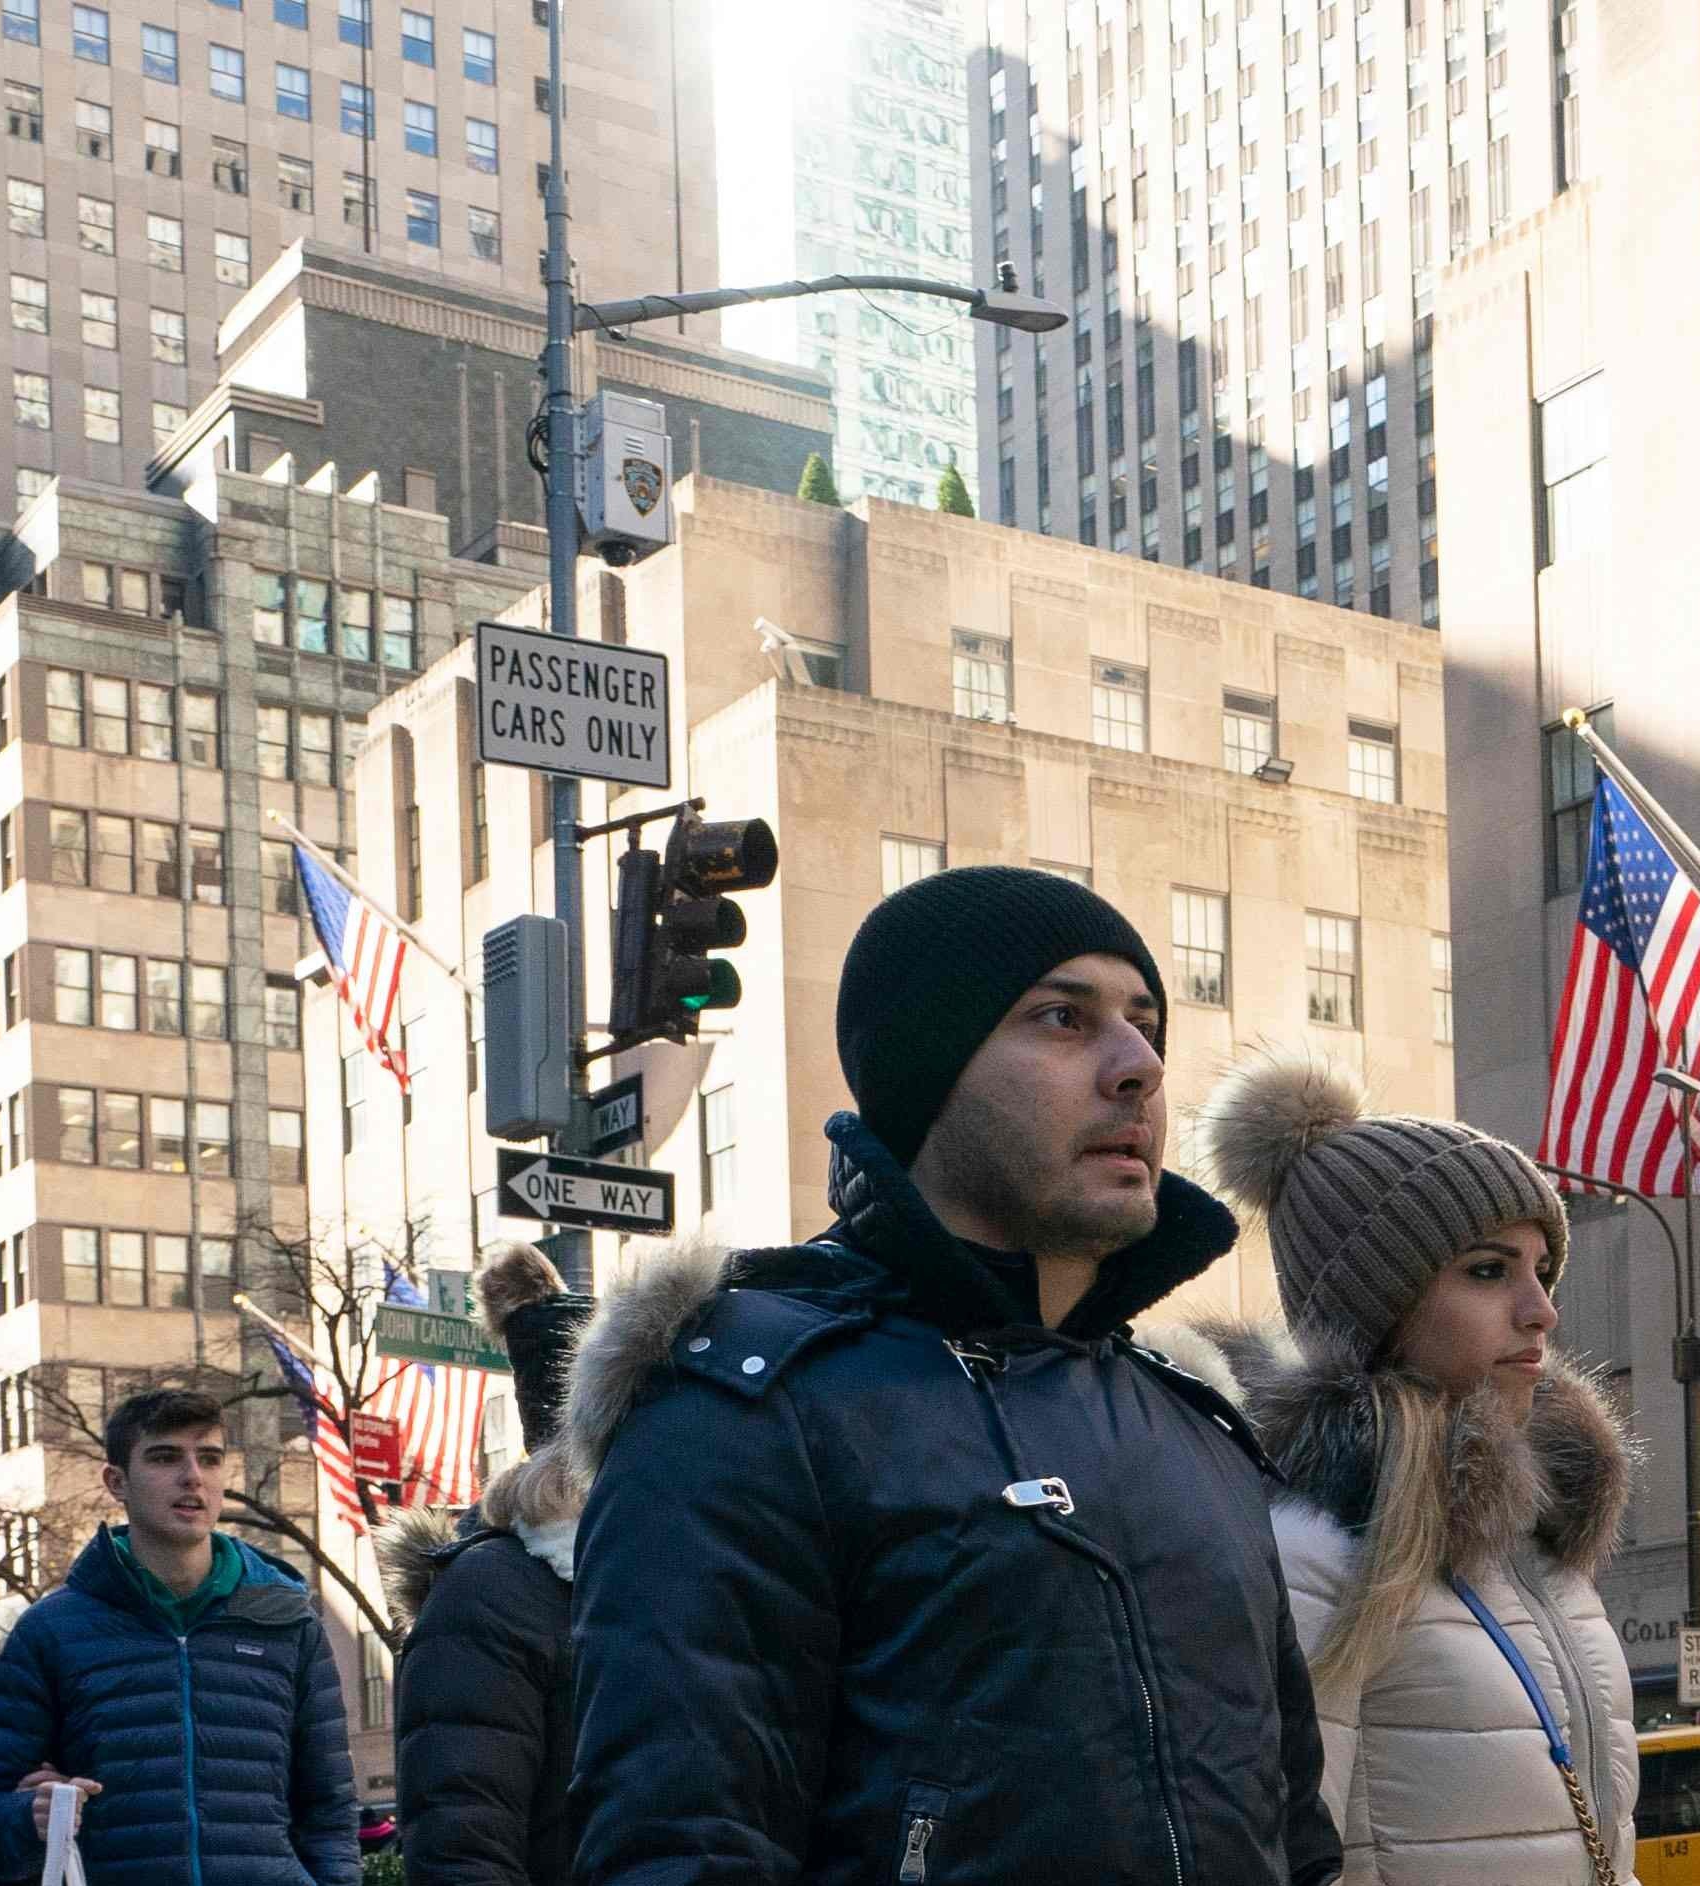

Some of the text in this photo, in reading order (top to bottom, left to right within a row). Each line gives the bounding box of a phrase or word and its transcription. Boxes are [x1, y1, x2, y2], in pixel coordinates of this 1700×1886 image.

[490, 644, 656, 710] PASSENGER
[491, 699, 657, 762] CARS ONLY
[526, 1173, 653, 1215] ONE WAY
[379, 1308, 416, 1342] JOHN
[1622, 1617, 1678, 1644] COLE
